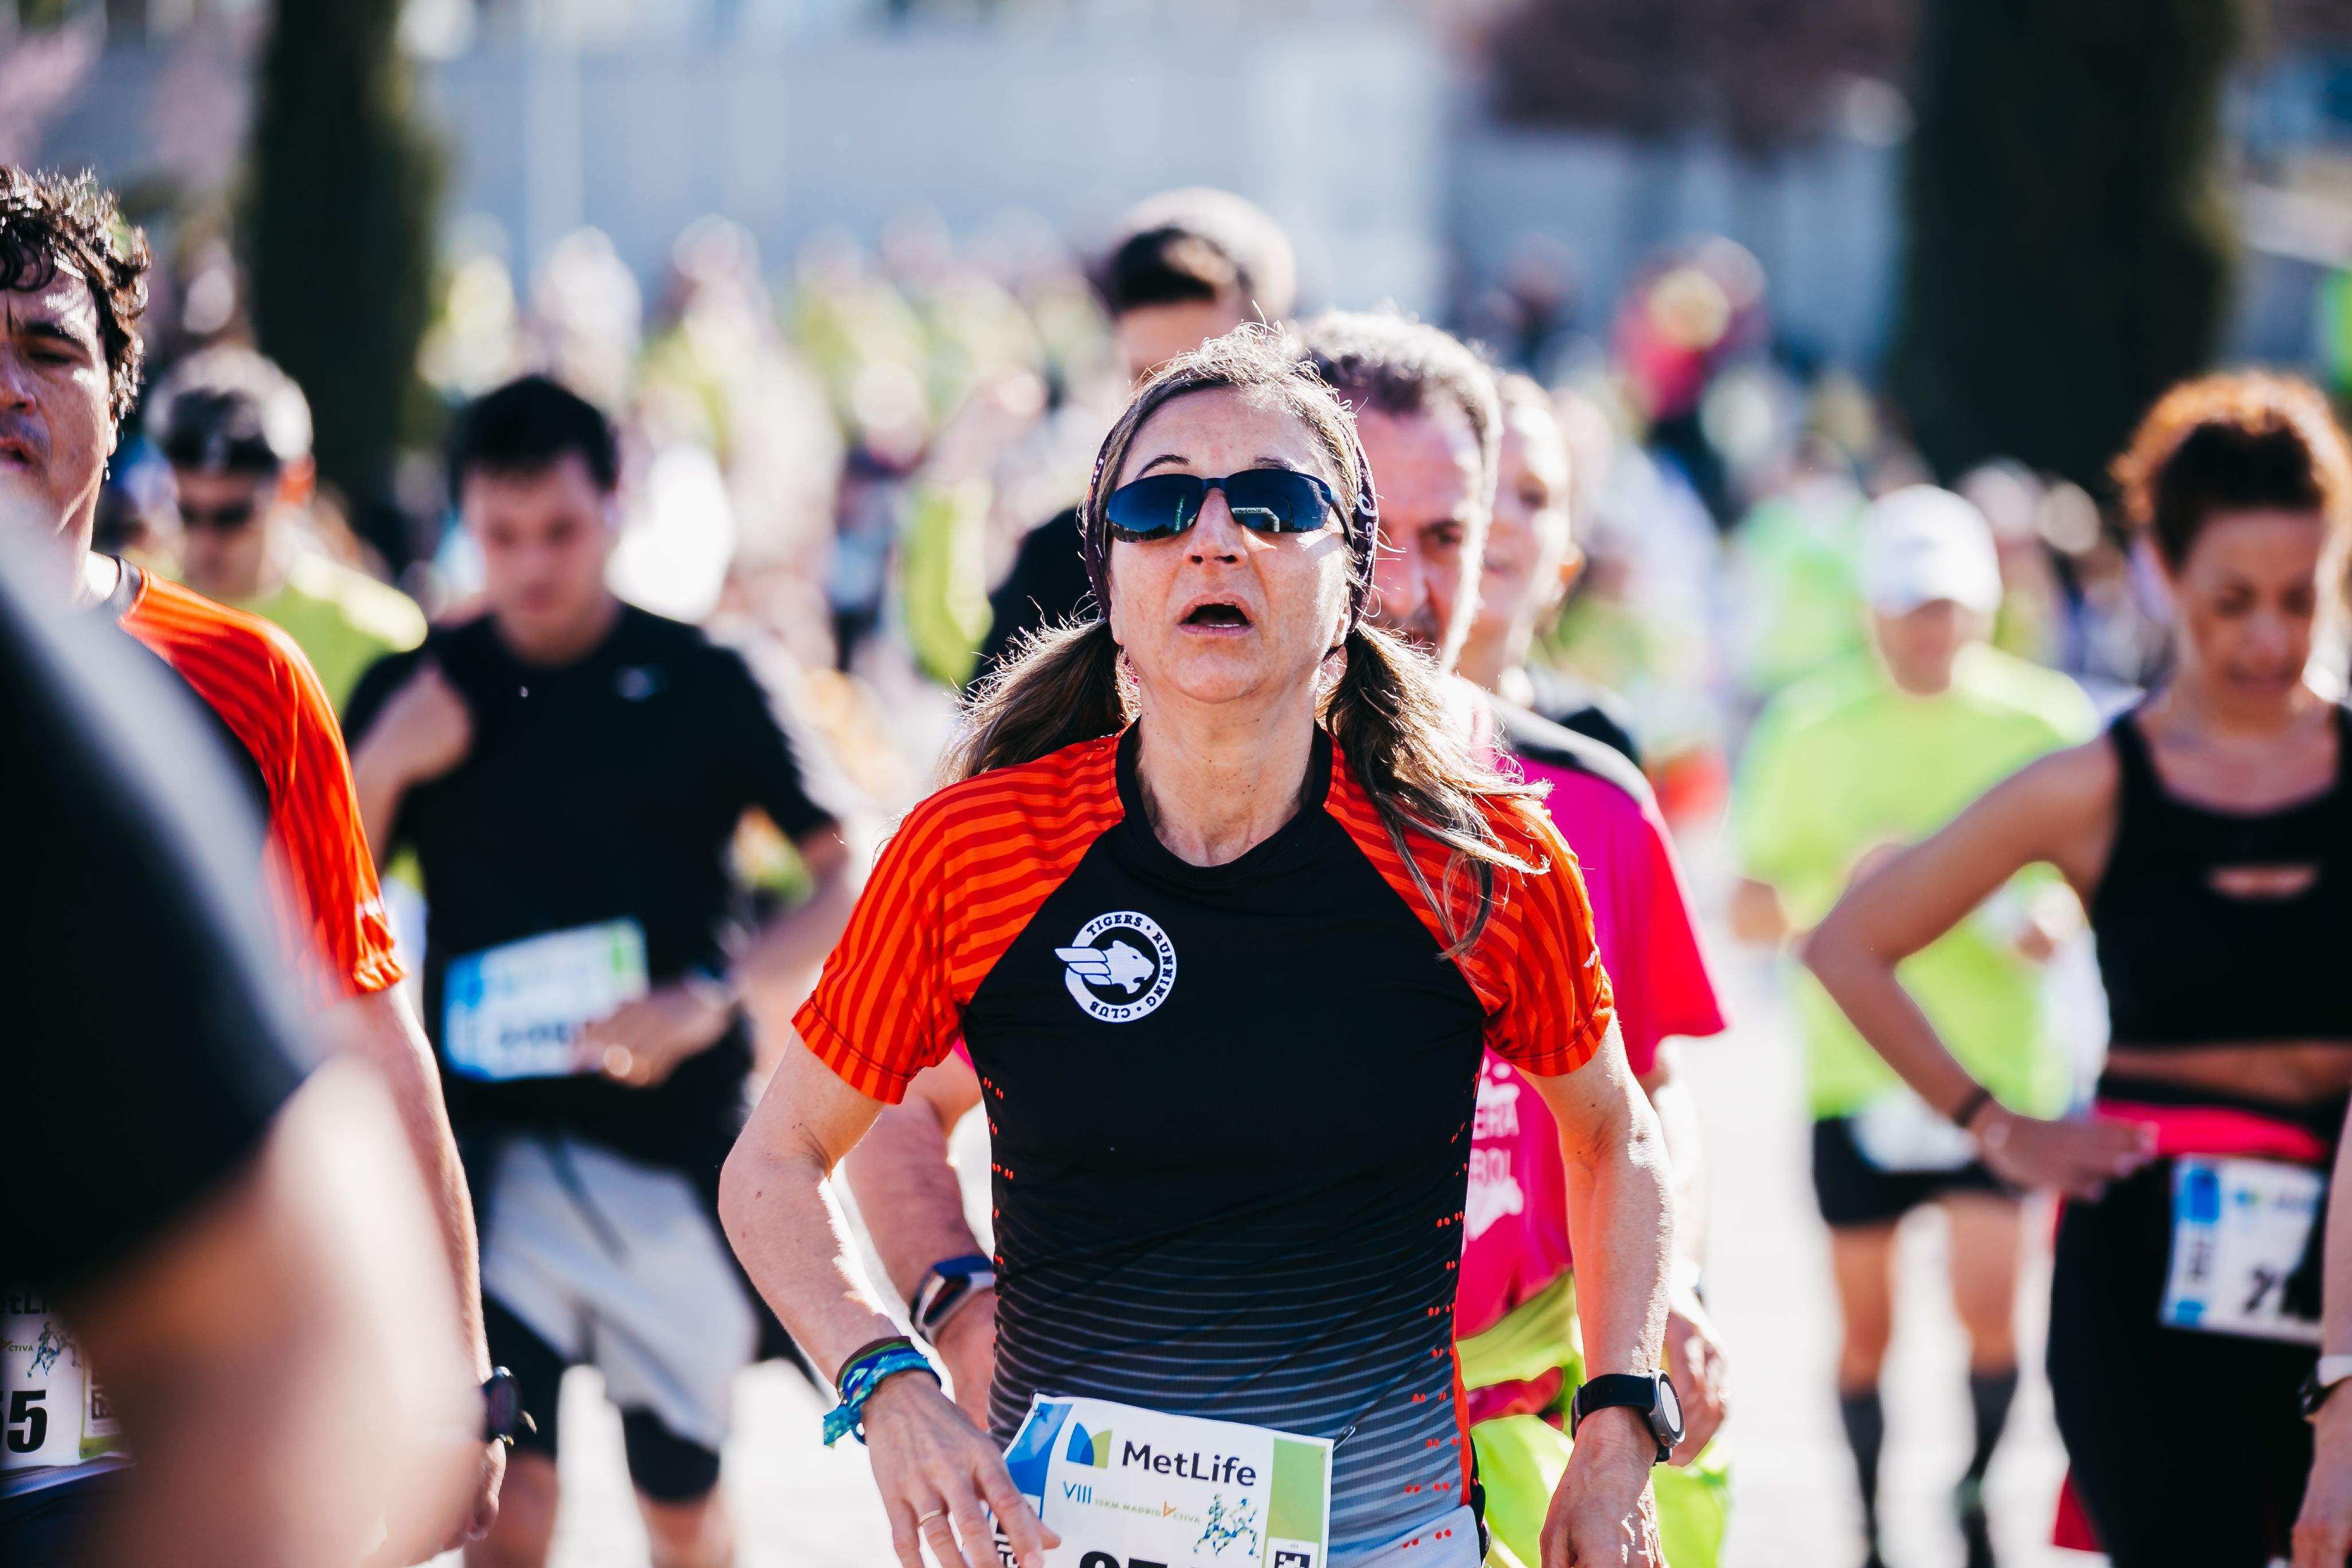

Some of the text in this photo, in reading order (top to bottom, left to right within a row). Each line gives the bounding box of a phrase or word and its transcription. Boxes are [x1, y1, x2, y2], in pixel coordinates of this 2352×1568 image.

[1087, 914, 1173, 1018] TIGERS RUNNING CLUB
[0, 1389, 48, 1453] 5
[1121, 1440, 1257, 1487] MetLife
[1063, 1480, 1092, 1504] VIII
